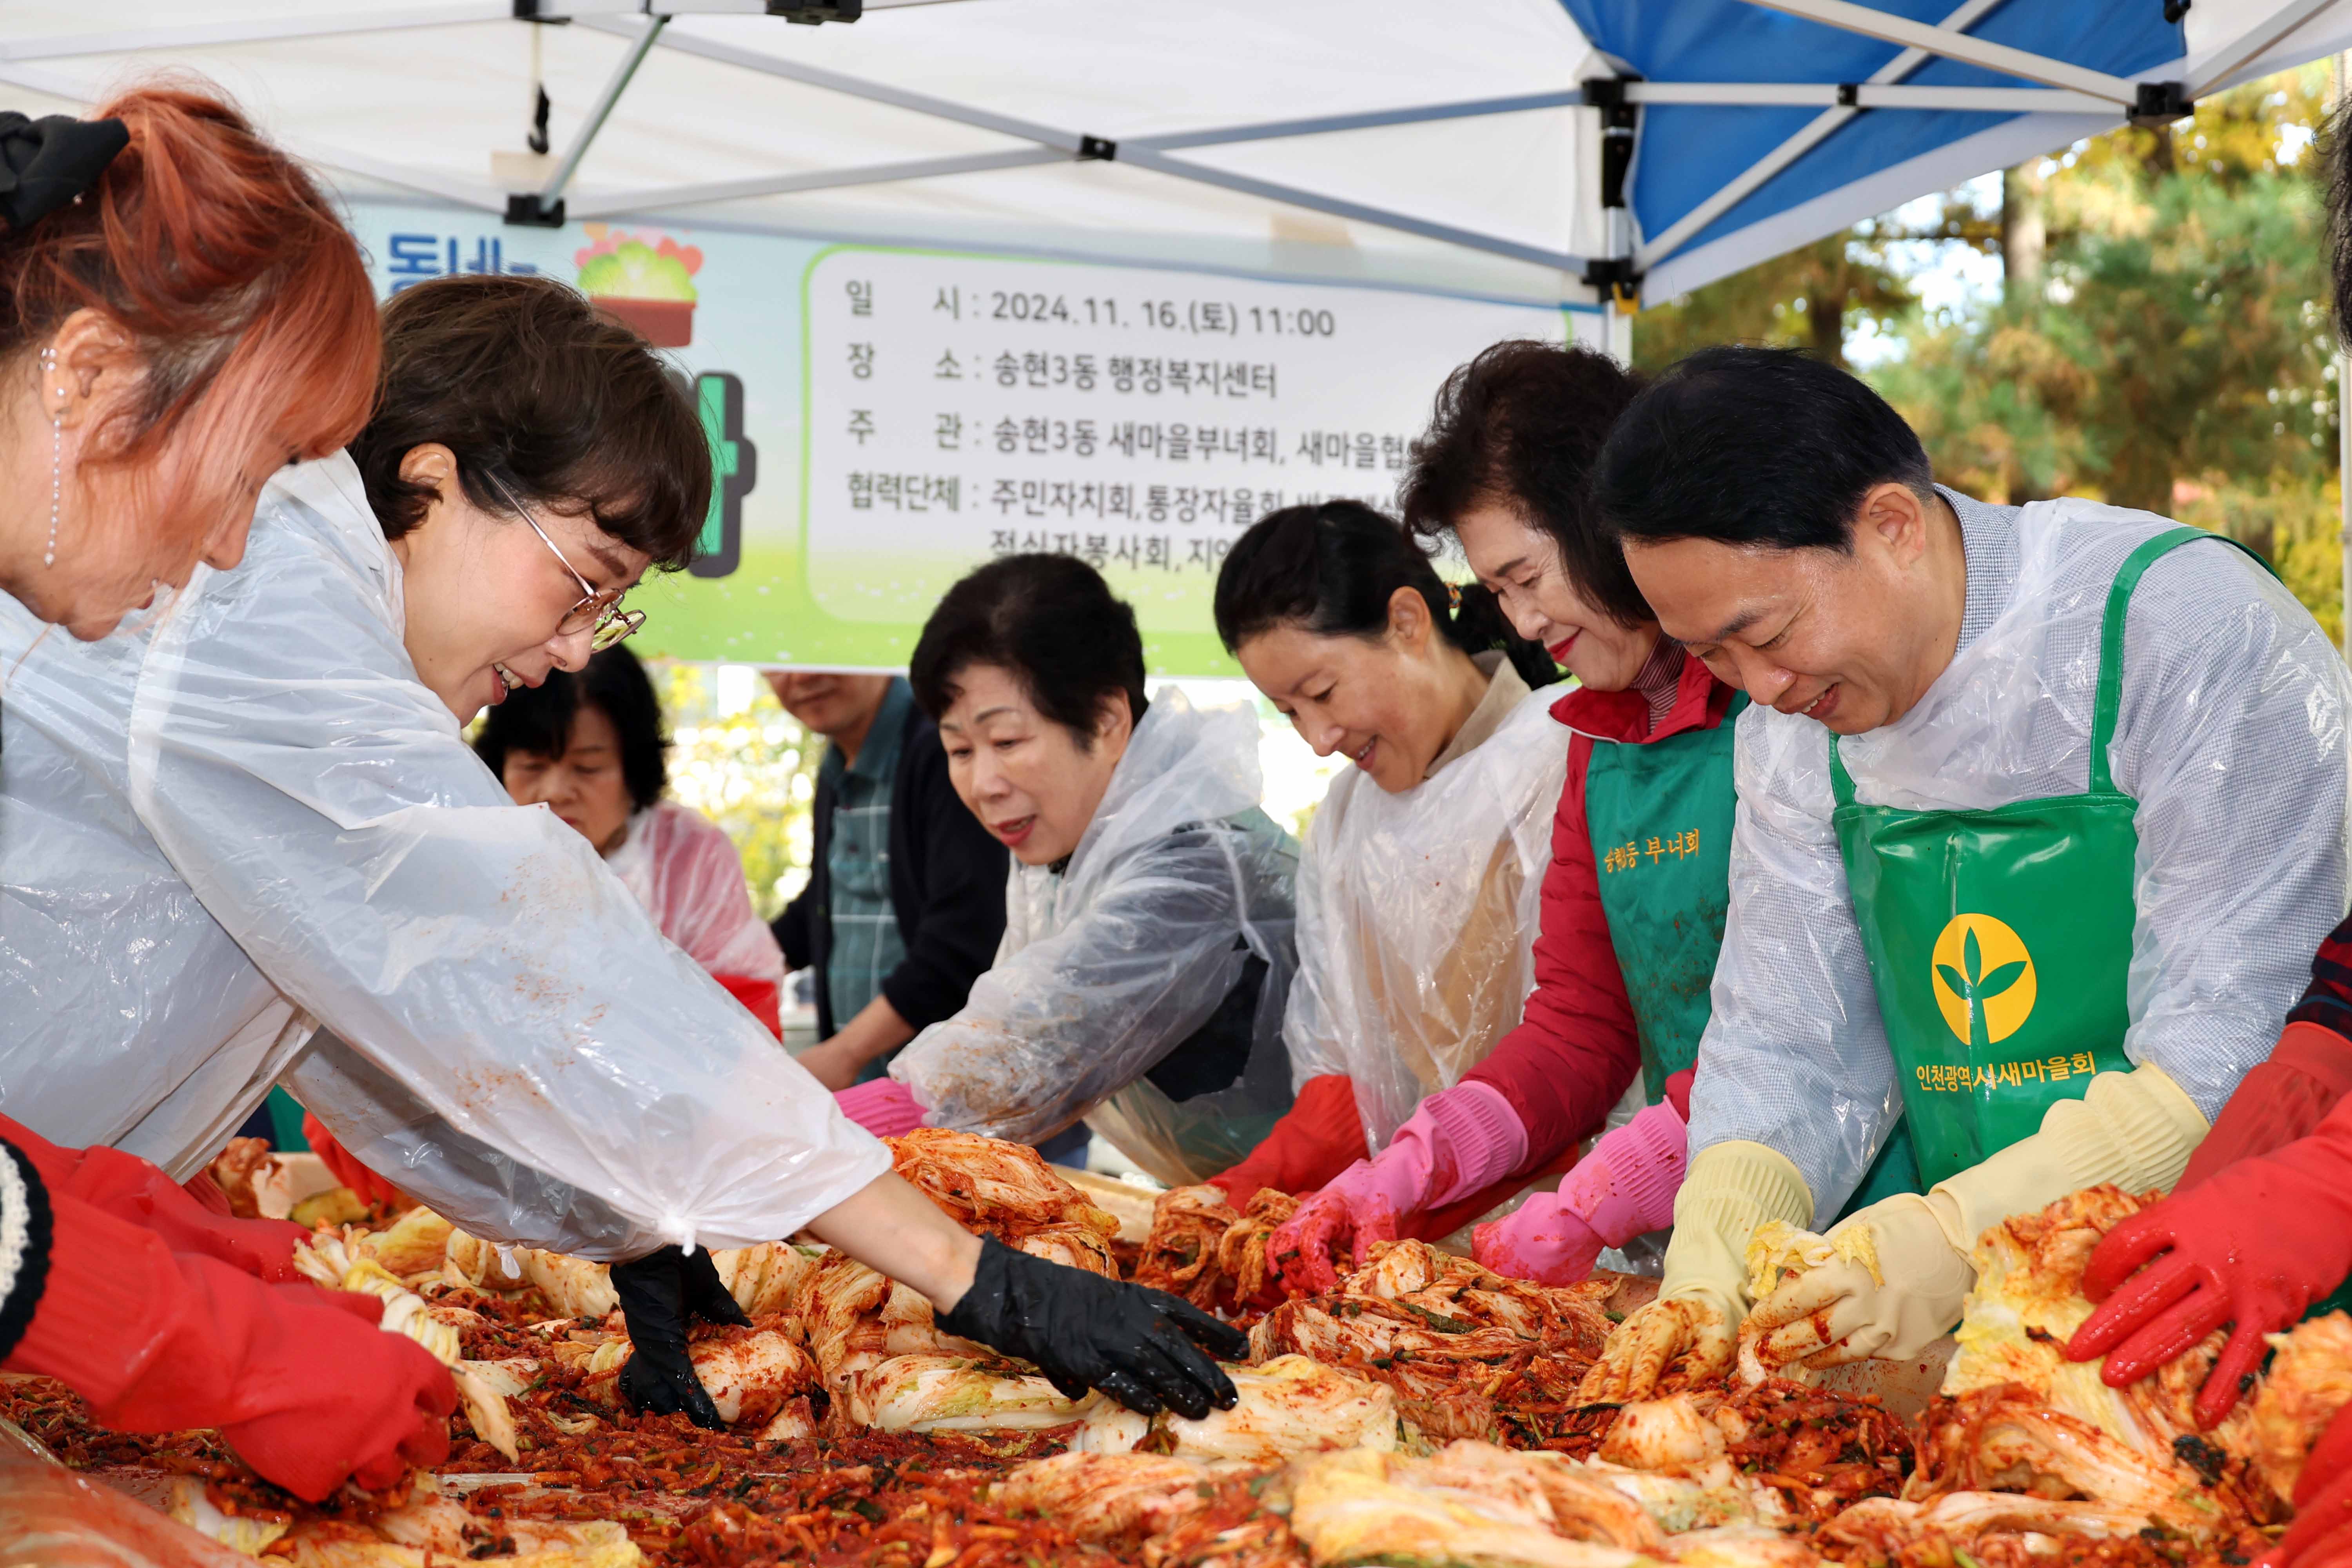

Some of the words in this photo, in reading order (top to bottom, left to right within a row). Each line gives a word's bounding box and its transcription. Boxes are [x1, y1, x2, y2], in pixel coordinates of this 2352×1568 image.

[845, 280, 872, 317] 일
[933, 286, 959, 320] 시
[1249, 307, 1335, 337] 11:00
[848, 342, 875, 380] 장
[935, 349, 962, 379] 소
[993, 349, 1099, 392] 송현3동
[1108, 355, 1277, 399] 행정복지센터
[848, 409, 875, 445] 주
[935, 413, 962, 450] 관
[993, 416, 1099, 457] 송현3동
[1108, 421, 1285, 465] 새마을부녀회,
[1296, 430, 1405, 469] 새마을협
[848, 471, 960, 512] 협력단체
[1644, 828, 1699, 864] 부녀회
[1916, 1051, 2096, 1092] 인천광역시새마을회
